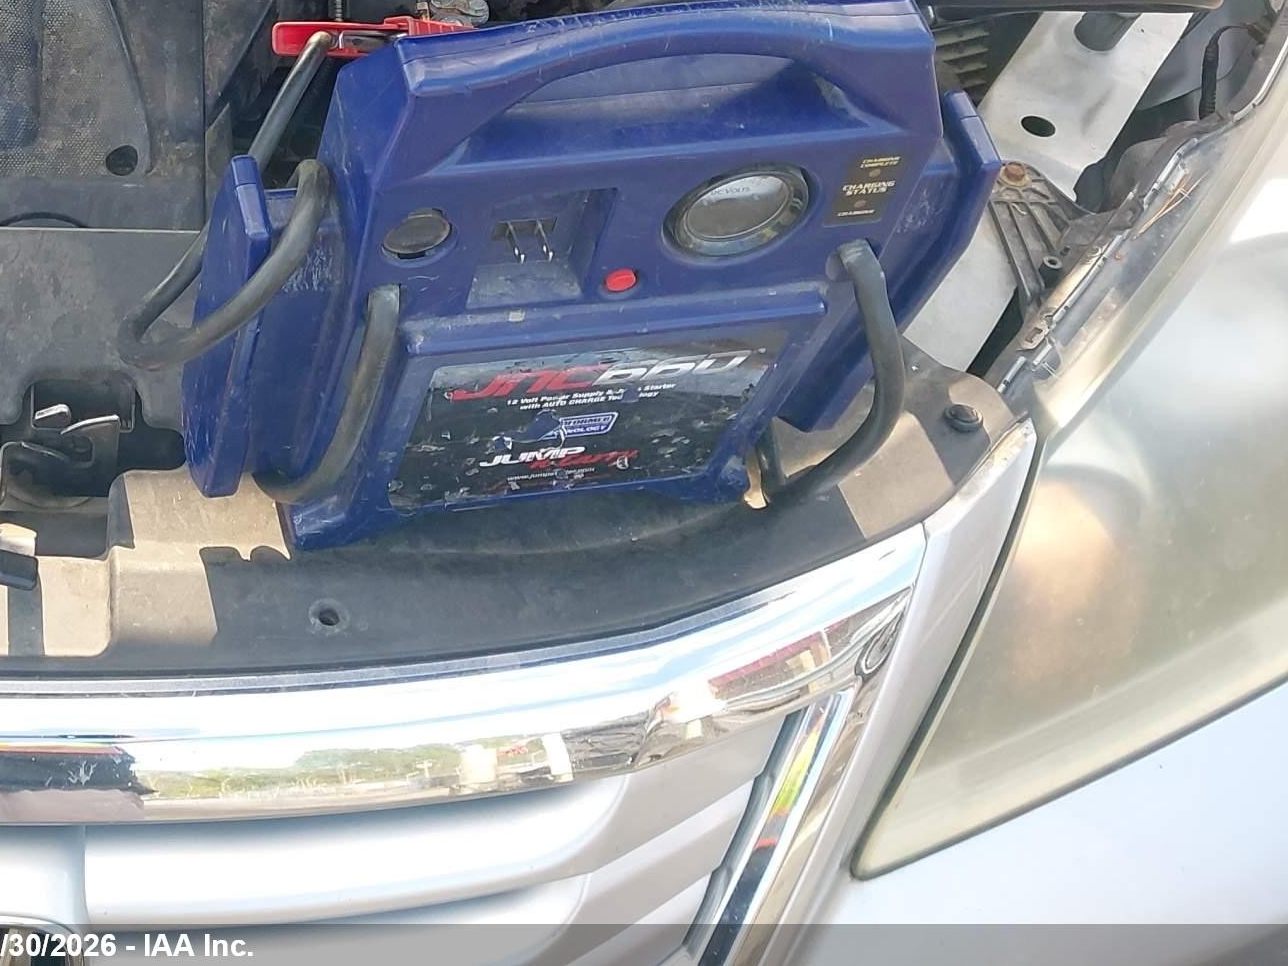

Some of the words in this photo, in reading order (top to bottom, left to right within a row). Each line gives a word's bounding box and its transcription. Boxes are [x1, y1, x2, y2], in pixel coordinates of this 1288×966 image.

[842, 180, 896, 192] CHARGING
[845, 185, 888, 197] STATUS
[571, 390, 605, 400] Supply
[643, 383, 677, 392] Starter
[519, 402, 542, 411] with
[542, 400, 567, 409] AUTO
[568, 397, 606, 406] CHARGE
[479, 447, 586, 467] JUMP
